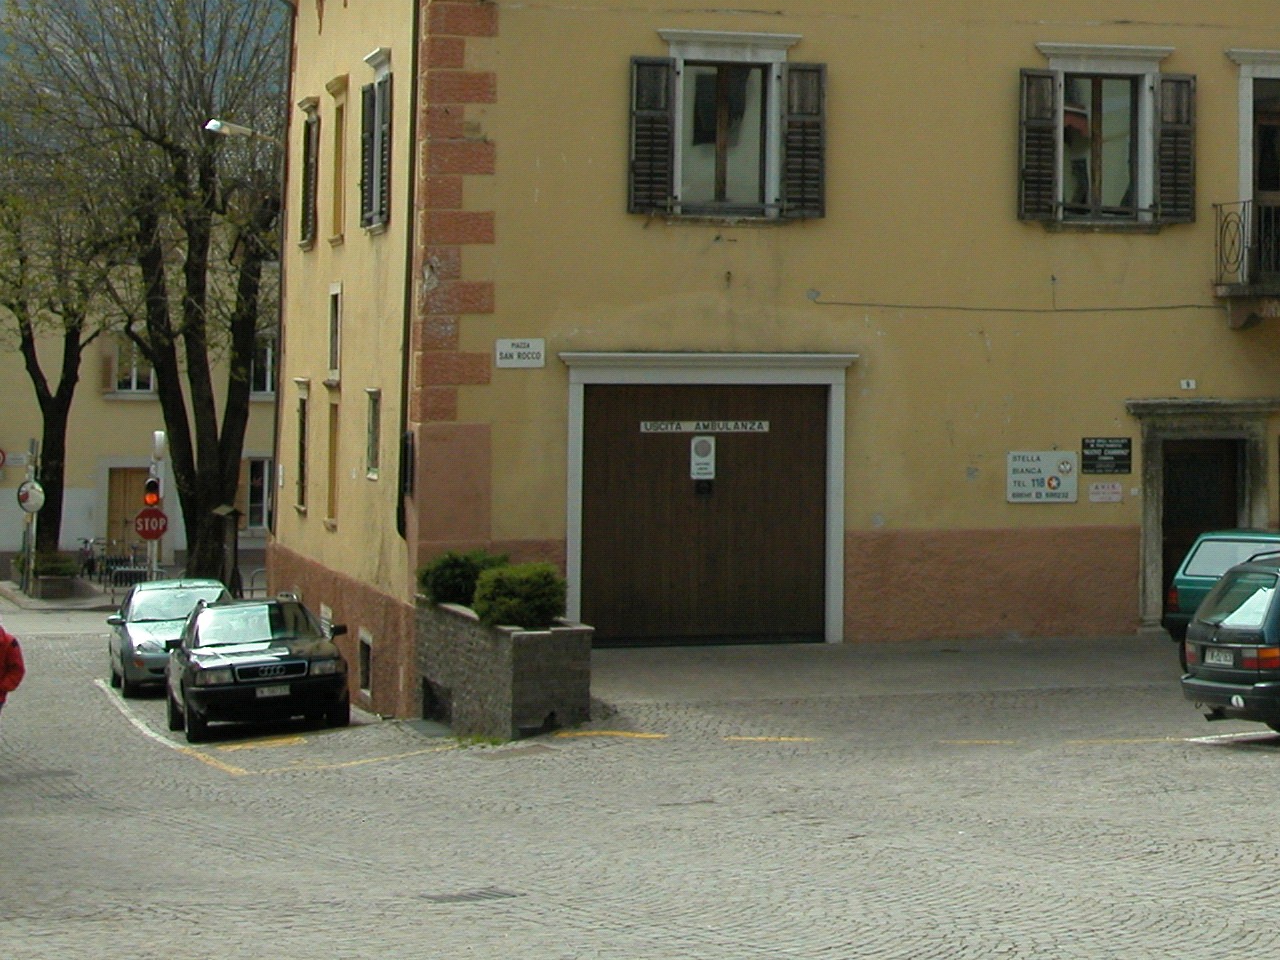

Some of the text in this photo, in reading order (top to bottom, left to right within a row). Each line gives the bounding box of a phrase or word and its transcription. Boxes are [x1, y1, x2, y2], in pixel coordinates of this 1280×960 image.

[499, 351, 541, 360] SAN ROCCO
[644, 422, 765, 431] USCITA AMBULANZA
[1012, 467, 1042, 475] BIANCA
[1013, 480, 1026, 488] TEL
[136, 518, 166, 530] STOP
